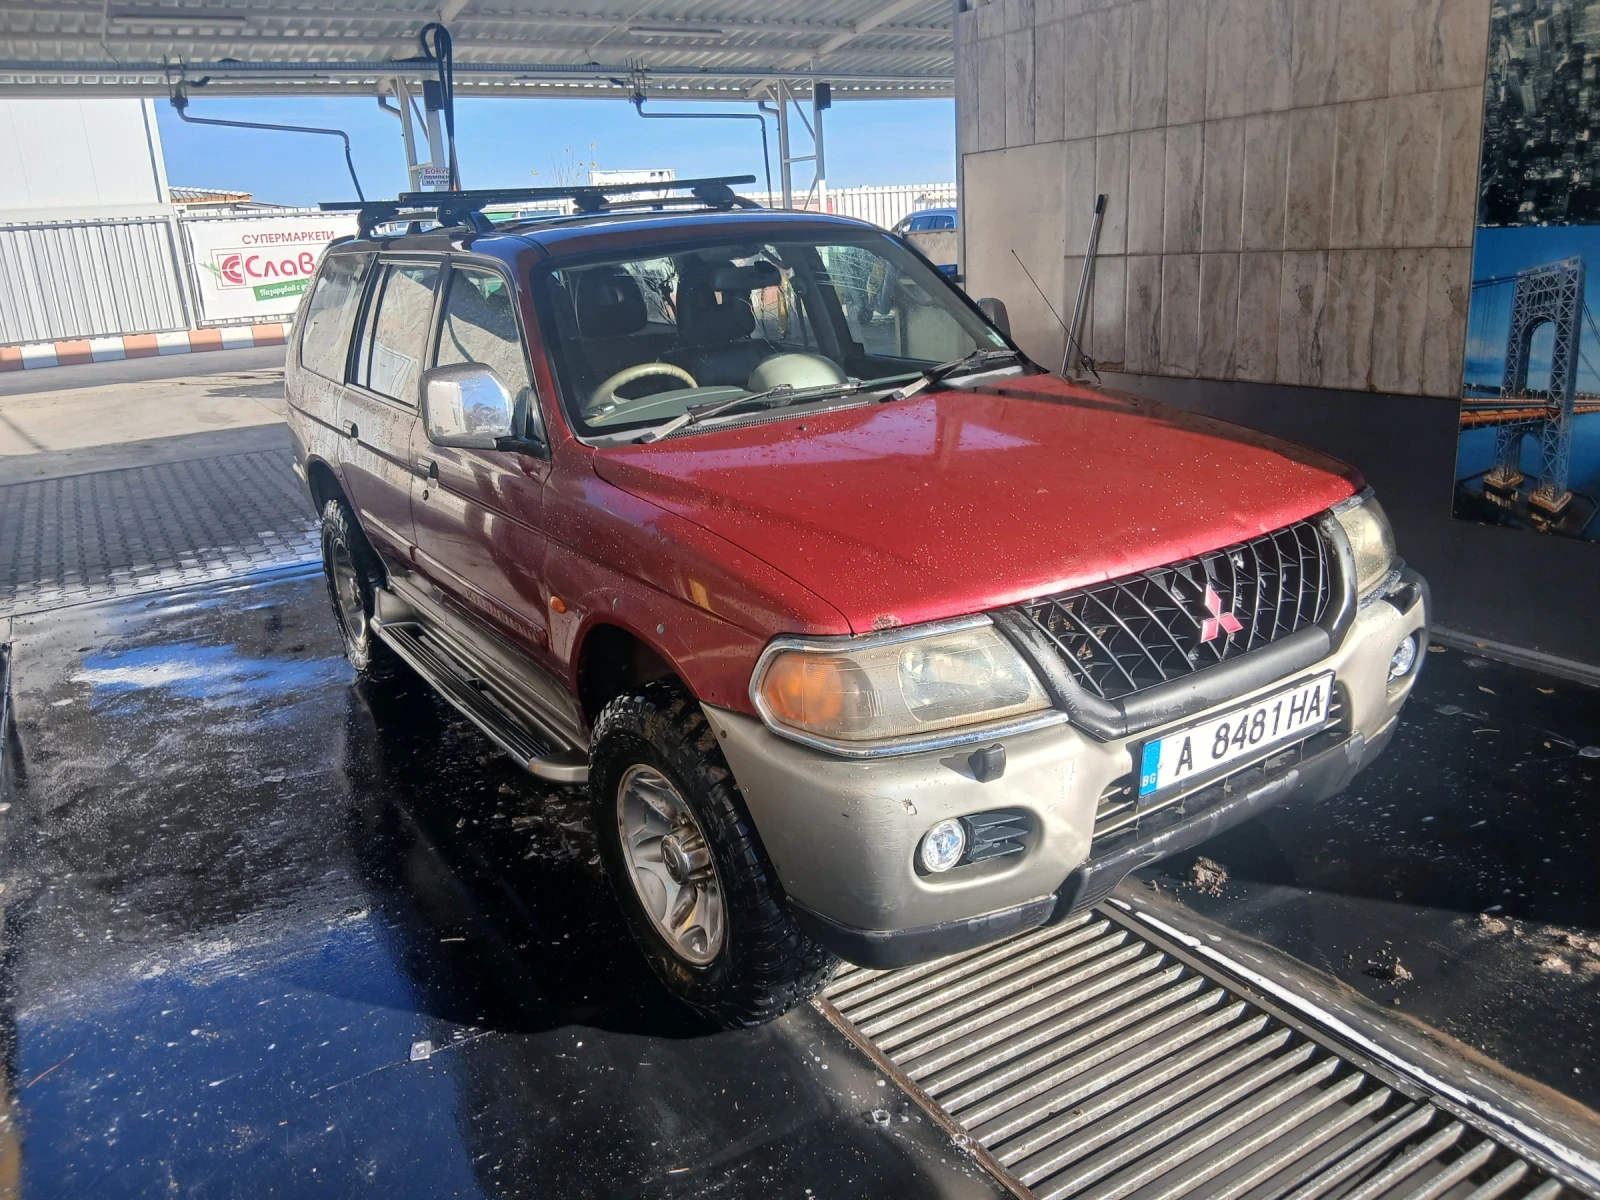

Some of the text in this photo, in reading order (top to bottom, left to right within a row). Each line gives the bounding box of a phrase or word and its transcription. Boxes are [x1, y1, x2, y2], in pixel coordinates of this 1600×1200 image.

[242, 230, 335, 244] СУПЕРМАРКЕТИ
[245, 252, 316, 277] Слав
[259, 284, 296, 297] Пазарувай
[1174, 736, 1193, 776] A
[1143, 773, 1156, 787] BG
